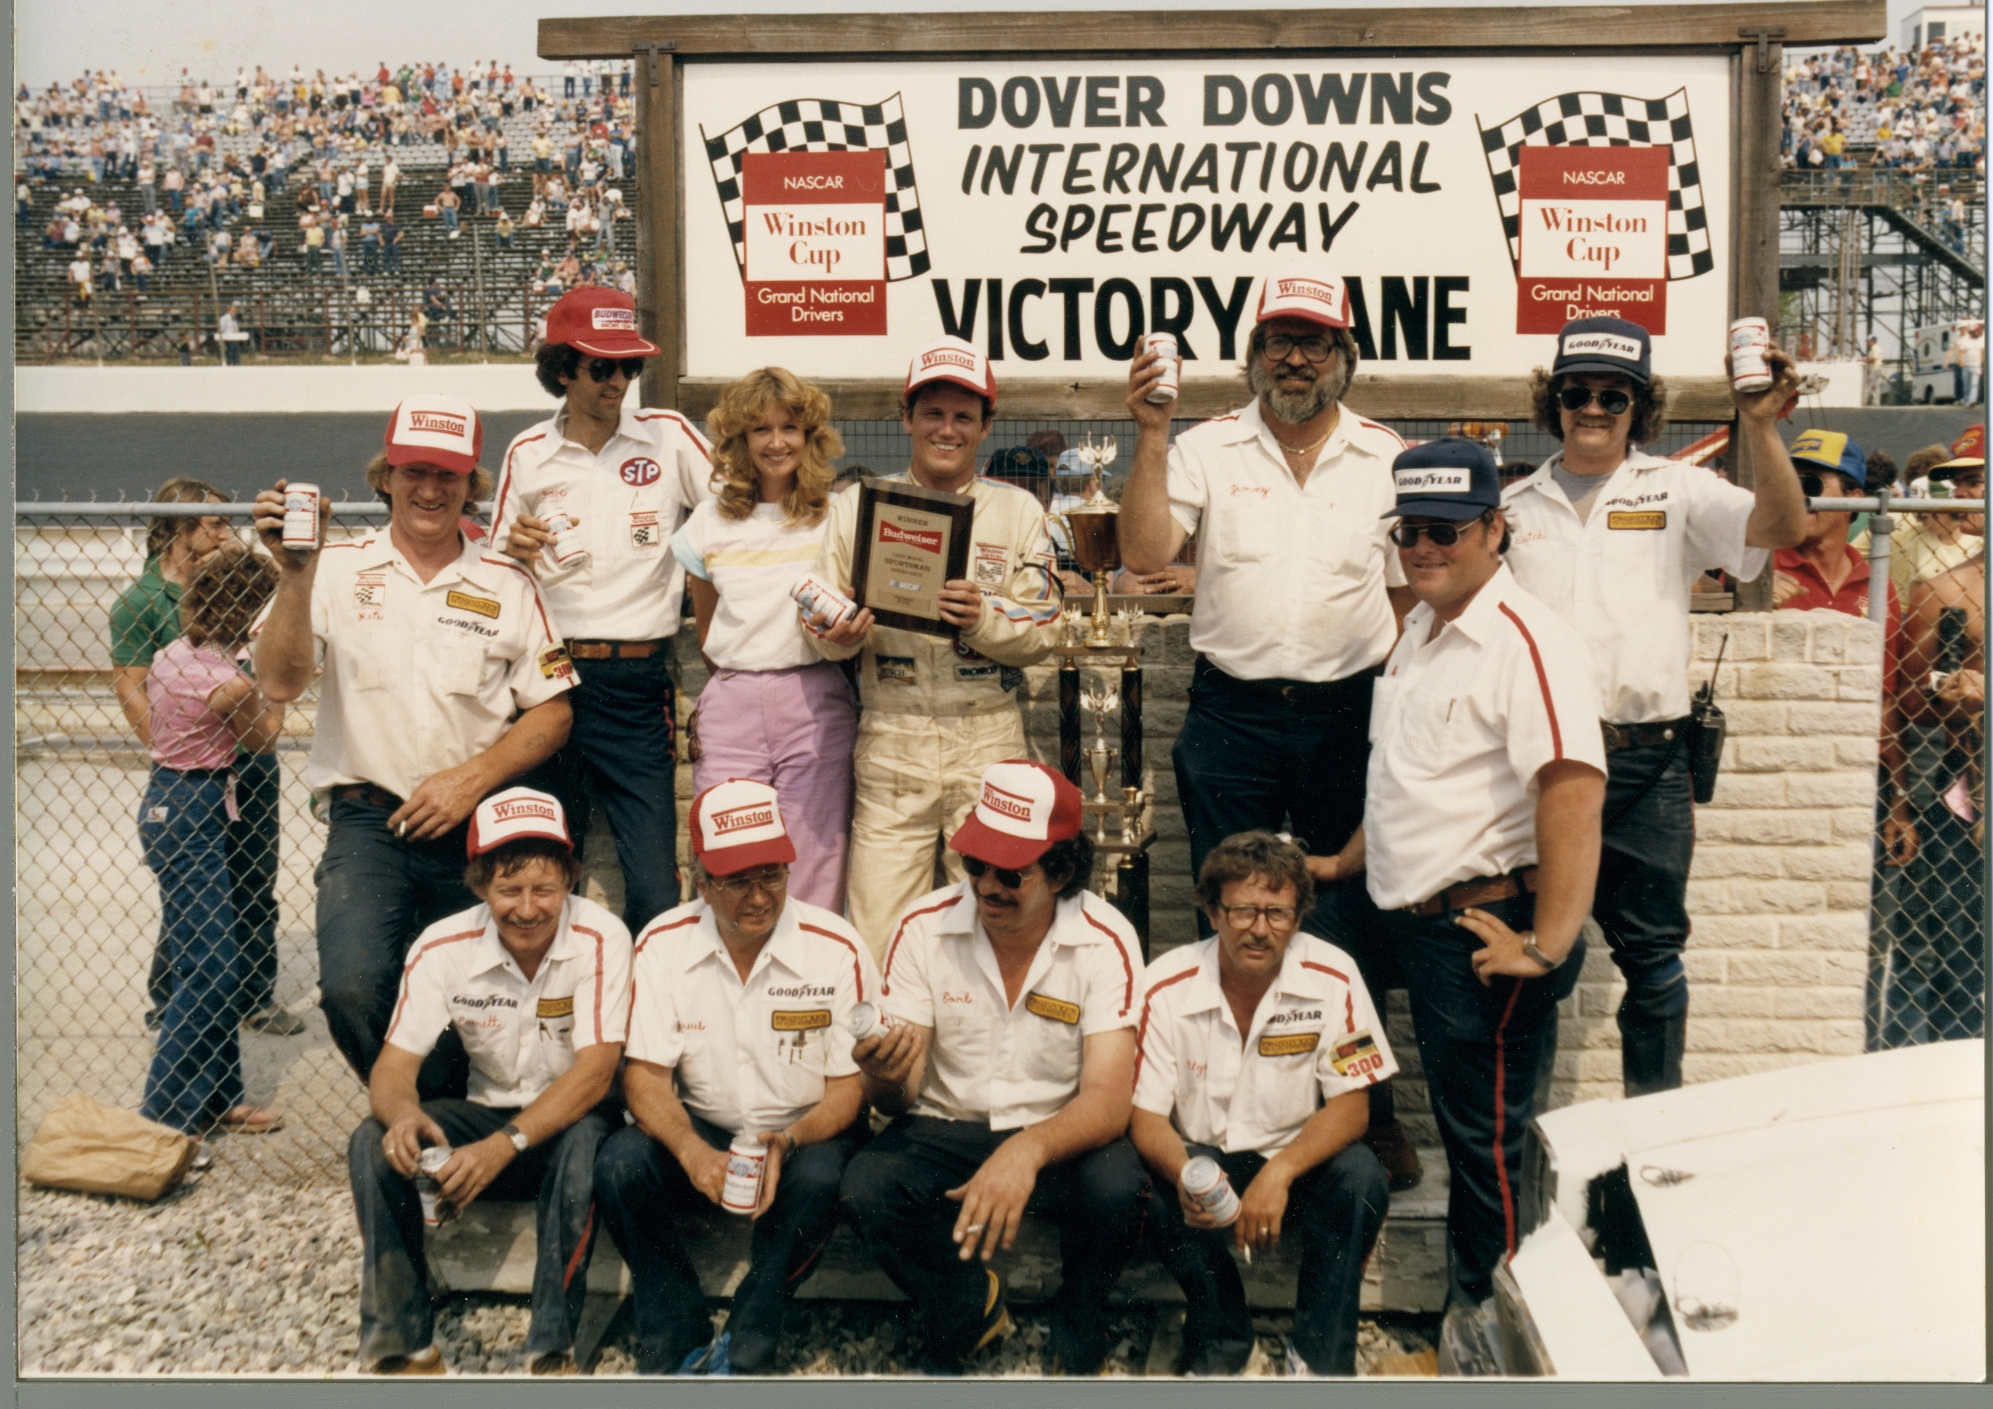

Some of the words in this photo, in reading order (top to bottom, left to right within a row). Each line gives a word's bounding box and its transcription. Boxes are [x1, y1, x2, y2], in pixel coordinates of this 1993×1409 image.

[958, 76, 1168, 129] DOVER
[1203, 71, 1452, 126] DOWNS
[962, 141, 1441, 195] INTERNATIONAL
[784, 175, 844, 190] NASCAR
[1563, 171, 1625, 185] NASCAR
[763, 212, 866, 237] Winston
[1020, 201, 1360, 253] SPEEDWAY
[1540, 208, 1648, 233] Winston
[789, 241, 840, 273] Cup
[1566, 237, 1621, 271] Cup
[758, 288, 806, 304] Grand
[811, 286, 874, 303] National
[1278, 283, 1332, 302] Winston
[1531, 285, 1582, 302] Grand
[1587, 285, 1654, 302] National
[792, 307, 844, 322] Drivers
[931, 277, 1254, 361] VICTORY
[1341, 276, 1471, 361] ANE
[1566, 304, 1621, 321] Drivers
[921, 353, 974, 367] Winston
[411, 415, 465, 433] Winston
[623, 460, 659, 484] STP
[897, 515, 929, 526] WINNER
[883, 527, 938, 546] Budweiser
[884, 558, 931, 572] SPORTSMAN
[494, 804, 554, 818] Winston
[983, 786, 1031, 817] Winston
[713, 810, 772, 831] Winston
[1346, 1053, 1383, 1078] 300
